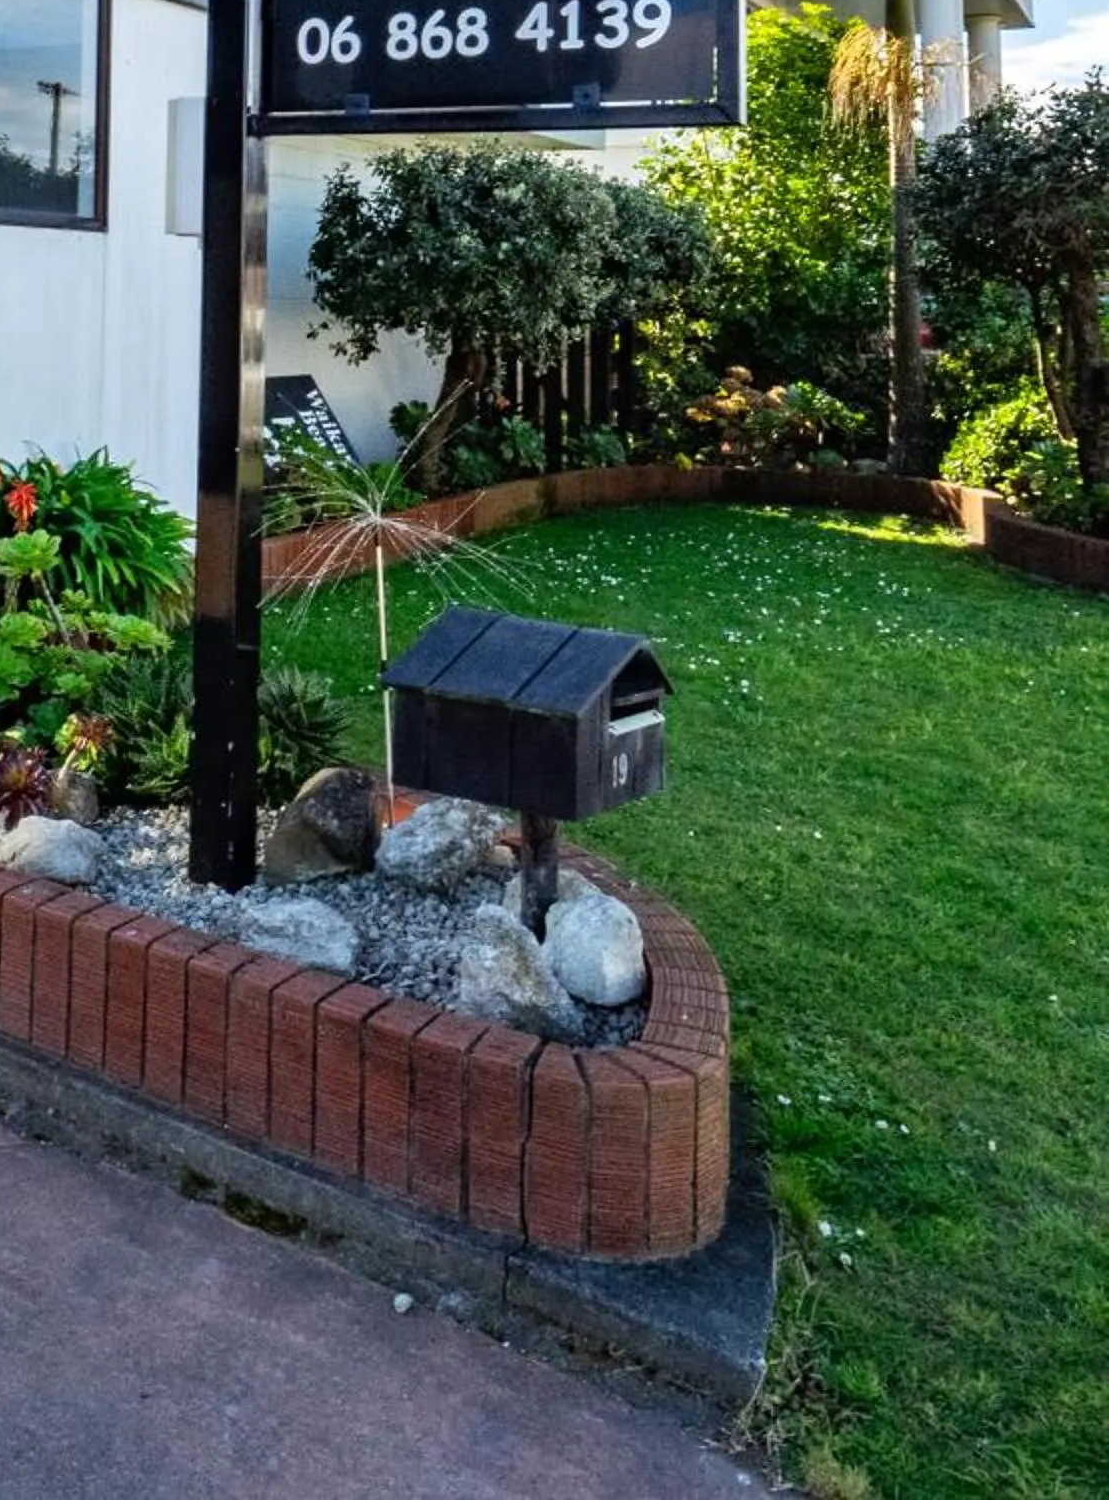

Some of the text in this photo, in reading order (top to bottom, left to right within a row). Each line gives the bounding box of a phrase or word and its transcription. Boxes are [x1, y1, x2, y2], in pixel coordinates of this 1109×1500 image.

[296, 16, 362, 65] 06
[385, 7, 490, 61] 868
[612, 753, 629, 789] 19
